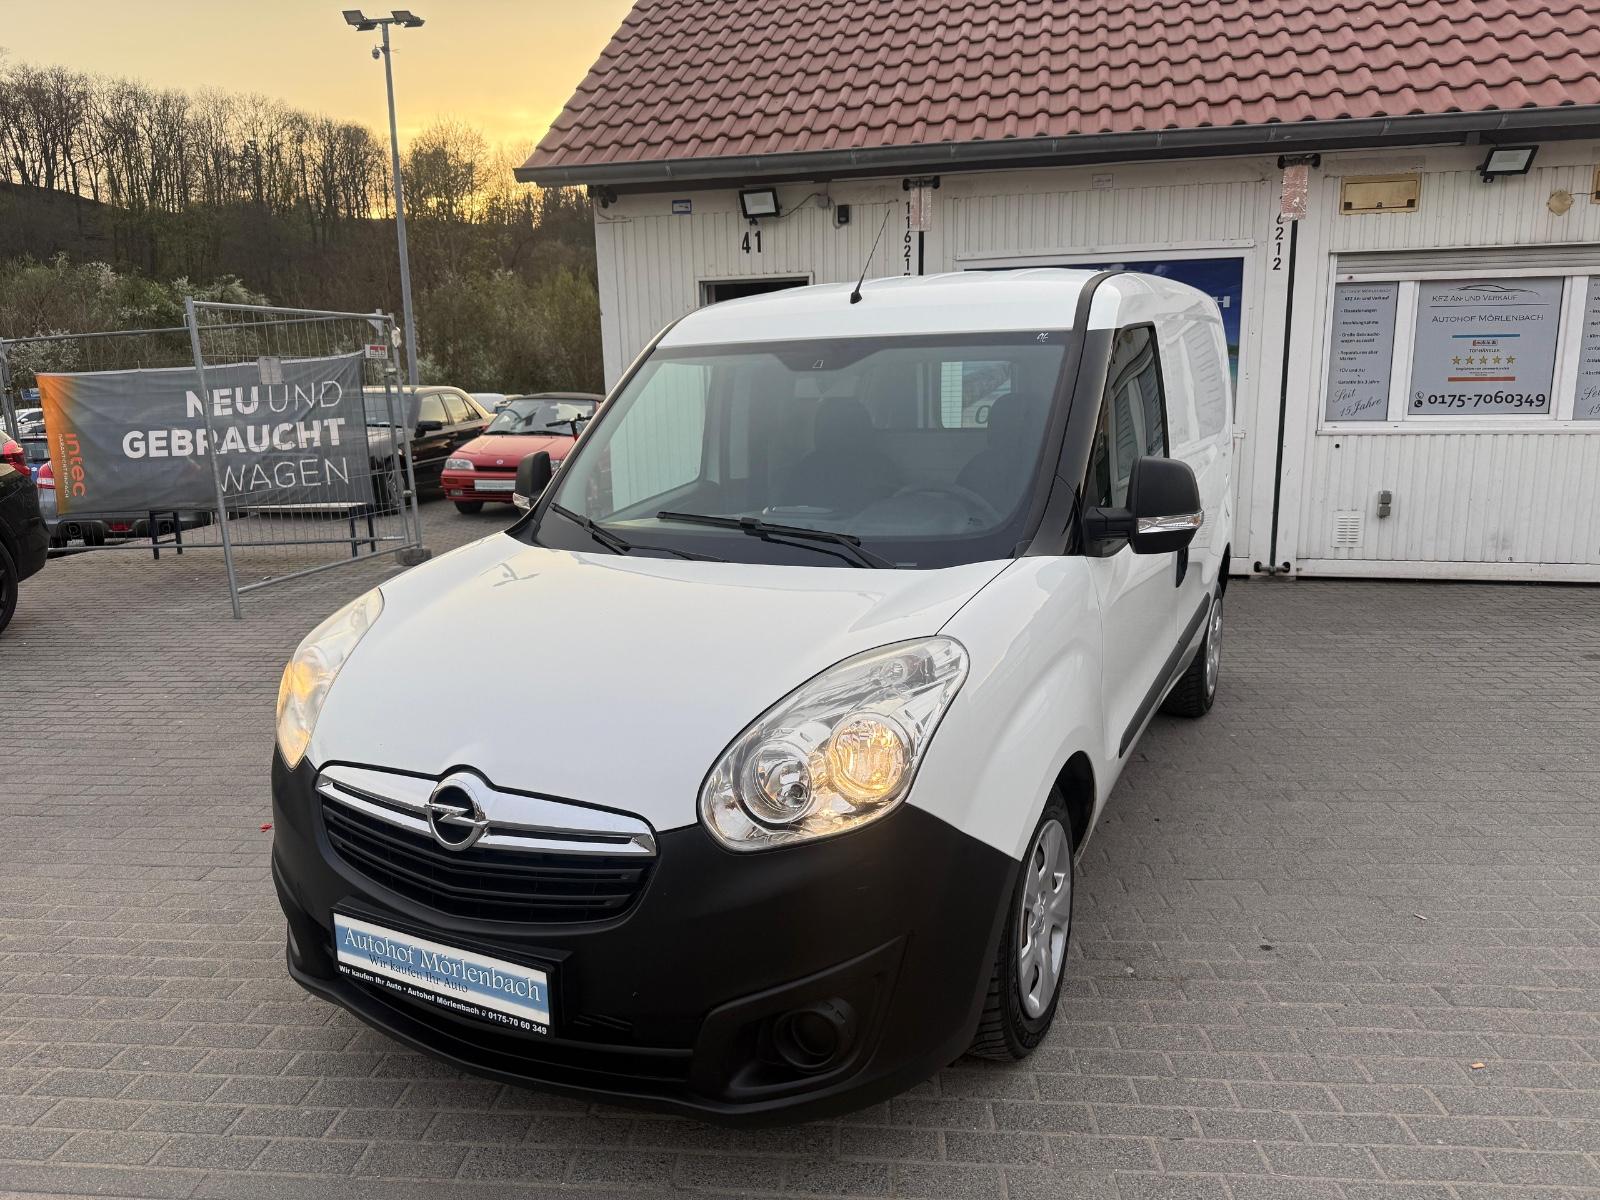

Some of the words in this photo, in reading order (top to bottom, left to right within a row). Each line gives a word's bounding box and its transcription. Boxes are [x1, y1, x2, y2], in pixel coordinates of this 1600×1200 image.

[741, 230, 762, 253] 41
[903, 201, 912, 276] 11621
[1431, 315, 1477, 323] AUTOHOF
[1478, 313, 1544, 322] MÖRLENBACH
[185, 385, 259, 418] NEU
[268, 380, 343, 413] UND
[1427, 390, 1546, 408] 0175-7060349
[122, 417, 346, 459] GEBRAUCHT
[65, 433, 86, 497] intec
[220, 456, 349, 493] WAGEN
[344, 927, 415, 965] Autohof
[420, 949, 542, 1002] Mörlenbach
[368, 953, 388, 969] Wir
[390, 959, 424, 980] kaufen
[425, 971, 441, 985] Ihr
[443, 977, 468, 993] Auto
[338, 964, 351, 974] Wir
[351, 968, 375, 982] kaufen
[375, 975, 385, 985] Ihr
[386, 980, 402, 991] Auto
[407, 987, 435, 1002] Autohof
[436, 996, 480, 1016] Mörlenbach
[488, 1011, 519, 1027] 0175-70
[520, 1019, 531, 1030] 60
[532, 1023, 547, 1035] 349
